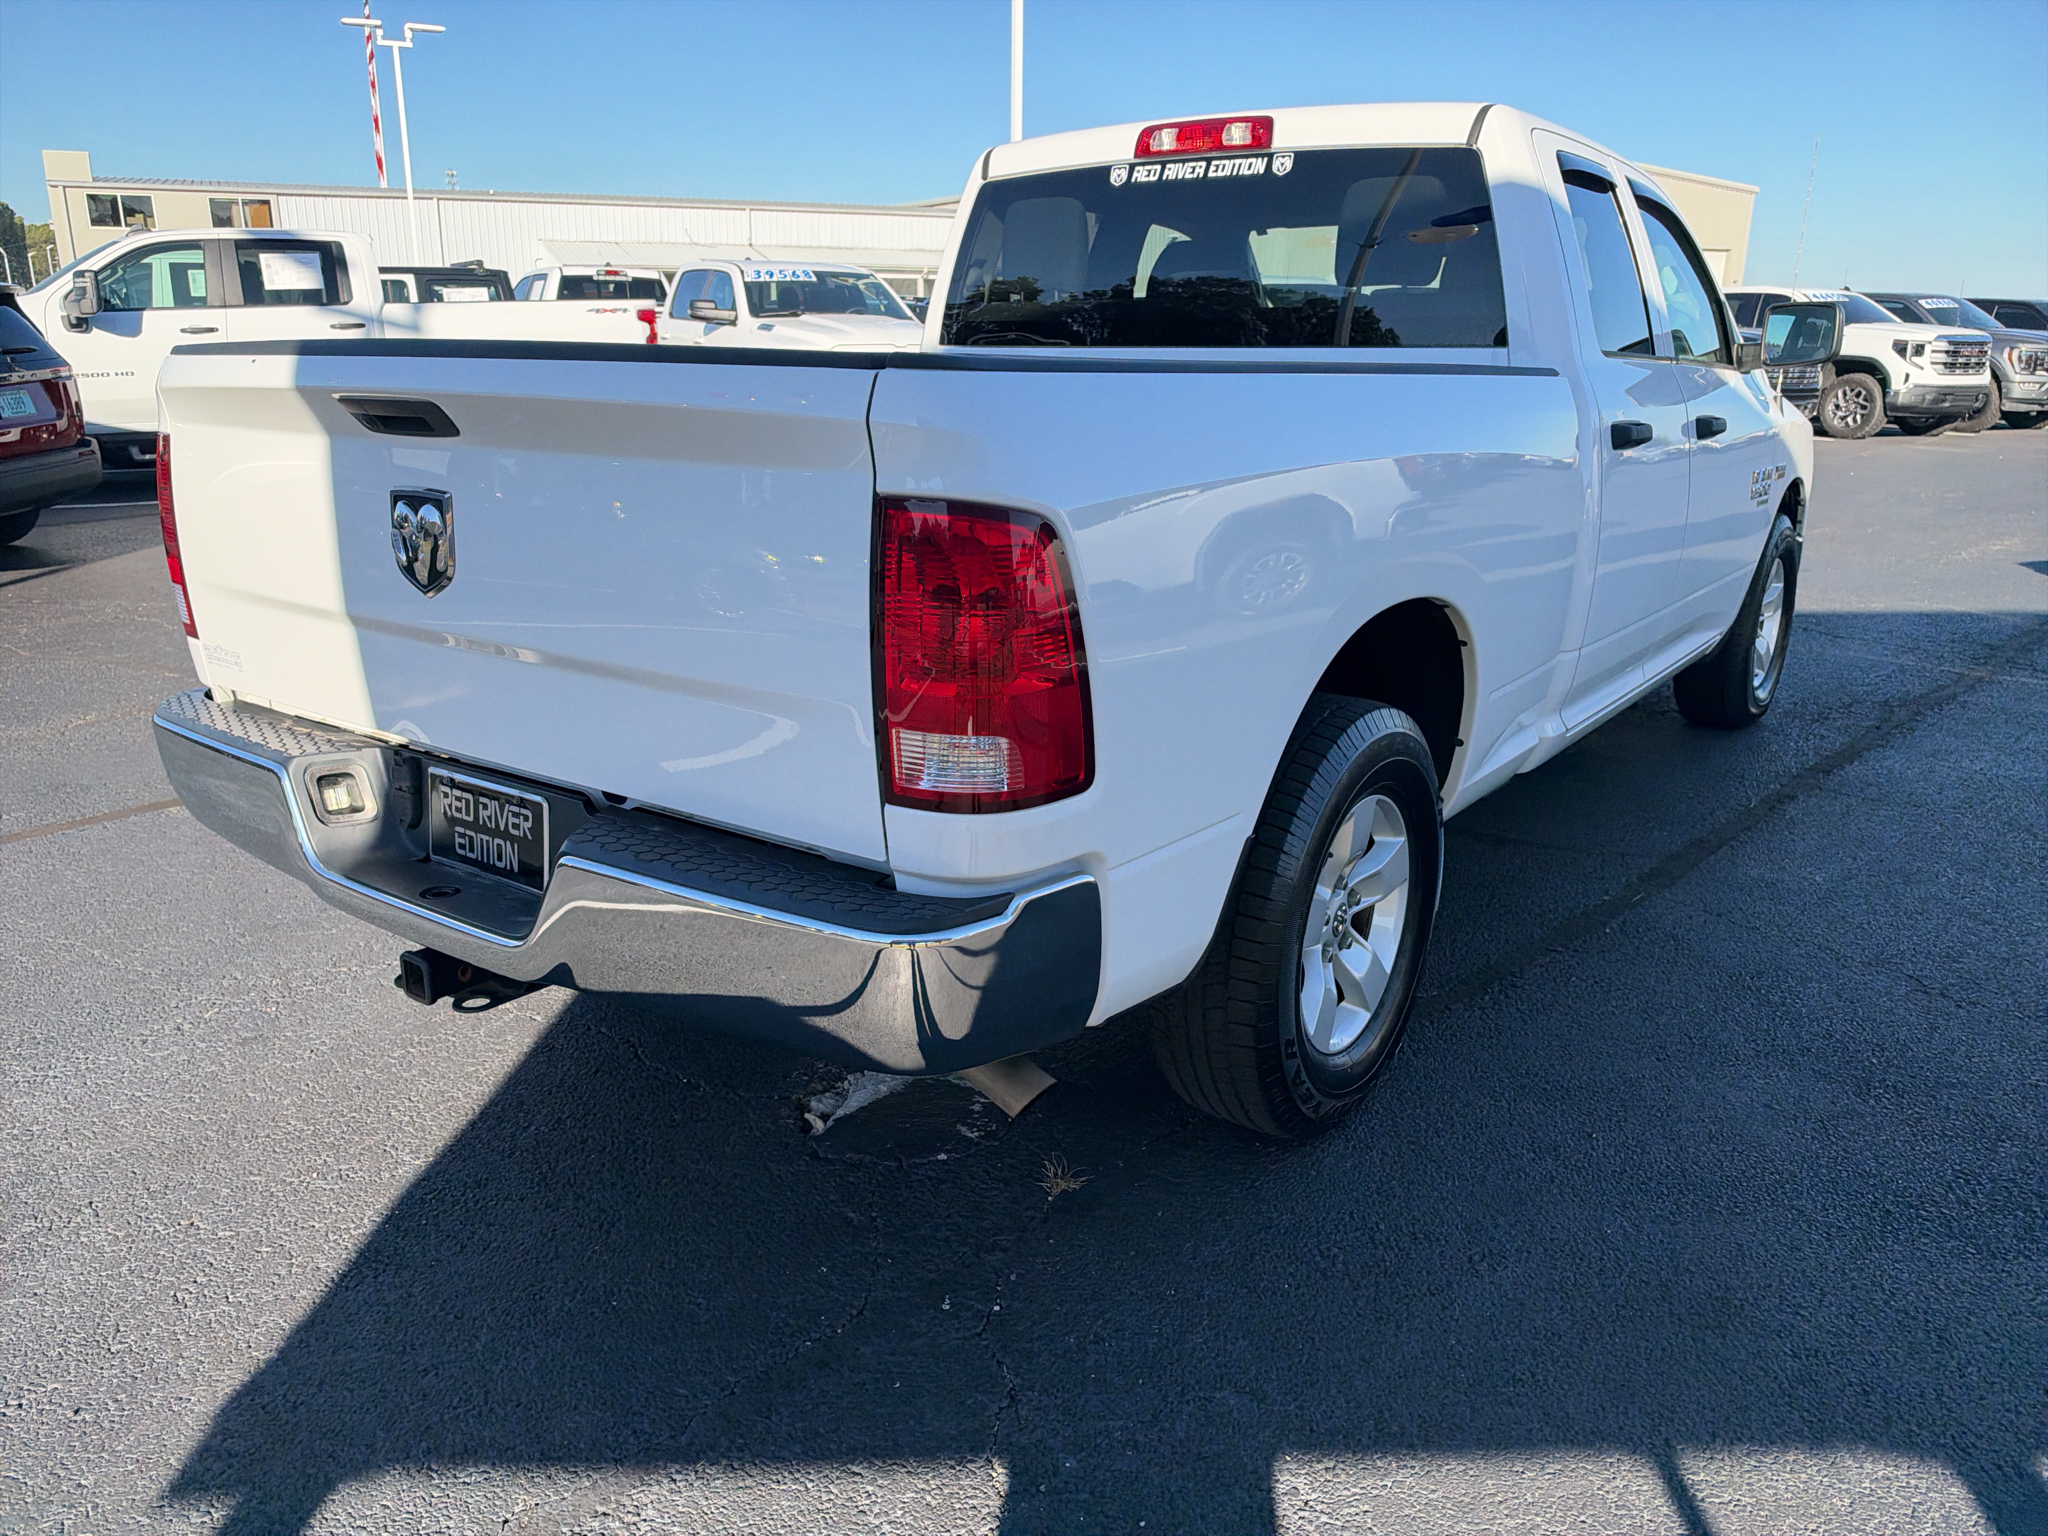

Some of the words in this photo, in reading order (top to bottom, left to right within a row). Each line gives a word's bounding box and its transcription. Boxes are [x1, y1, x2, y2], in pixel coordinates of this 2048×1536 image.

[1131, 164, 1162, 183] RED
[1163, 161, 1207, 180] RIVER
[1208, 157, 1268, 177] EDITION
[440, 785, 474, 822] RED
[479, 796, 532, 840] RIVER
[455, 826, 518, 873] EDITION
